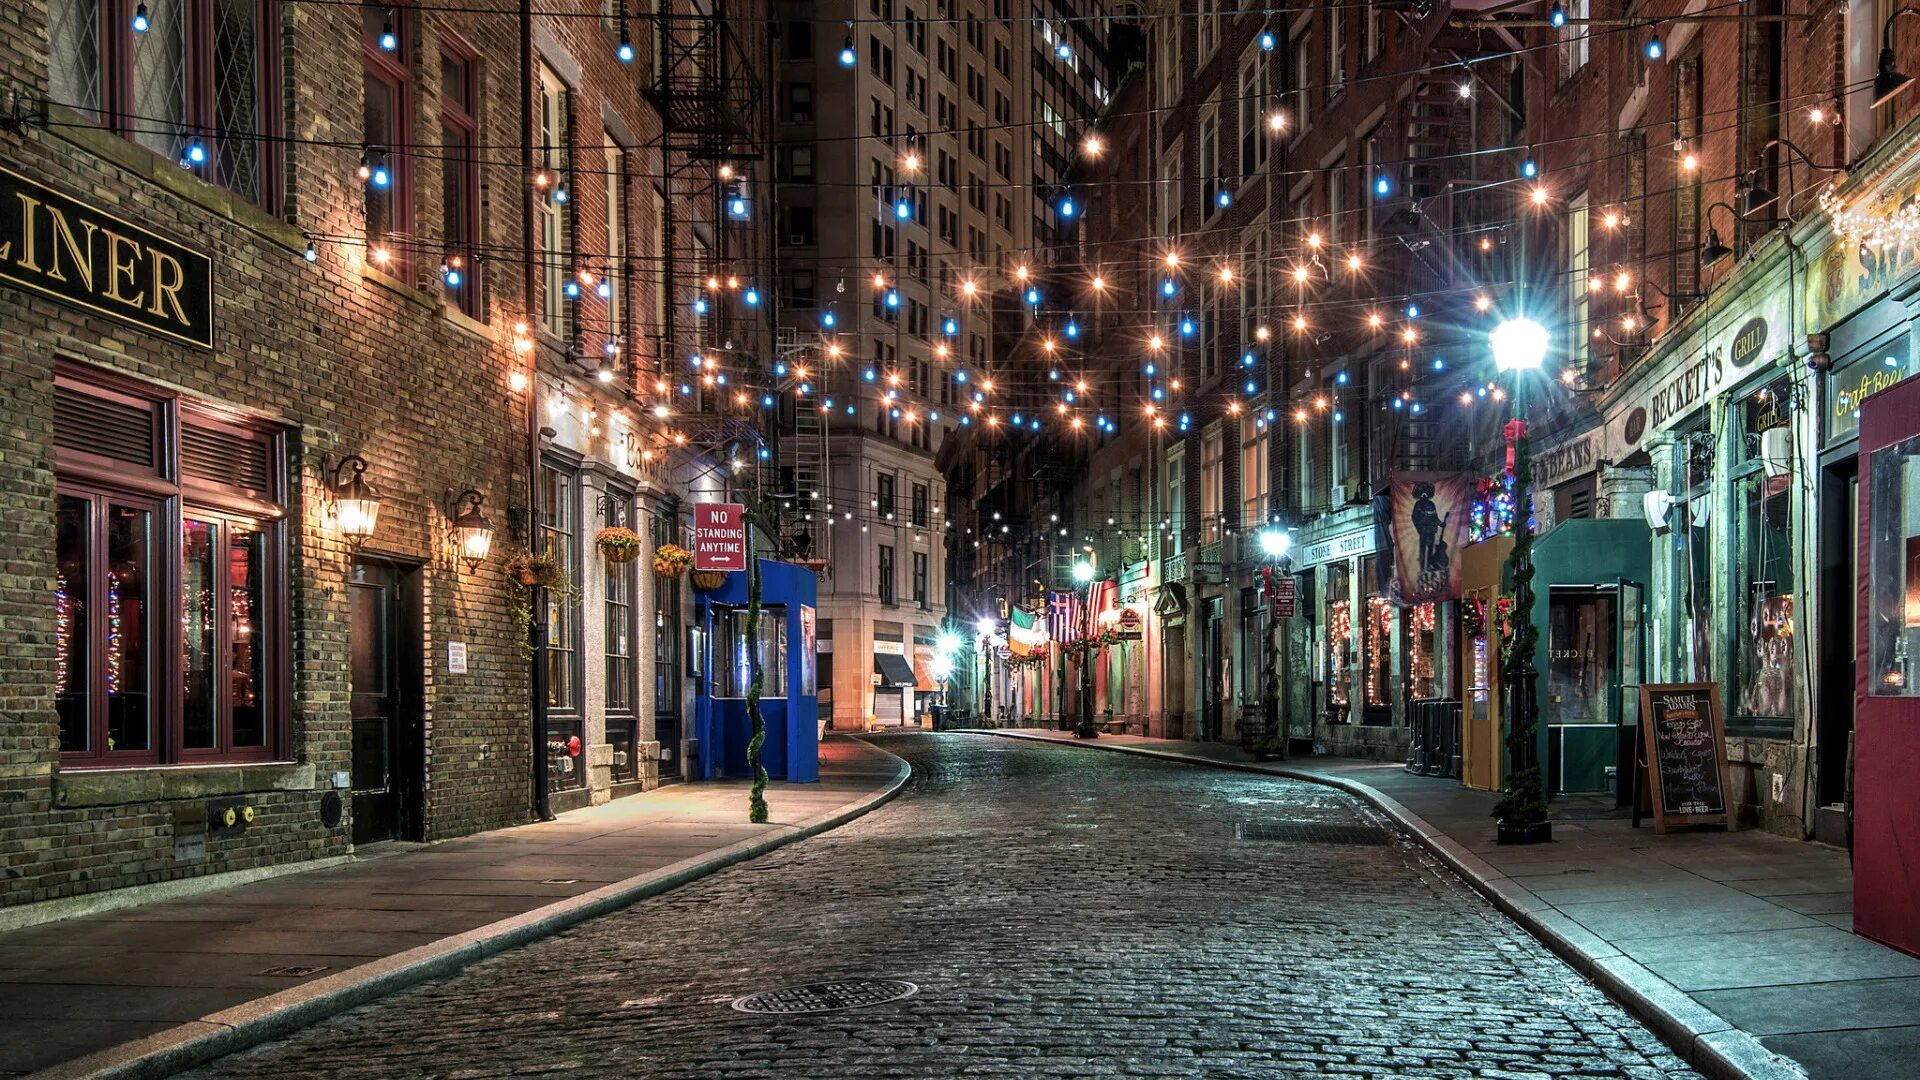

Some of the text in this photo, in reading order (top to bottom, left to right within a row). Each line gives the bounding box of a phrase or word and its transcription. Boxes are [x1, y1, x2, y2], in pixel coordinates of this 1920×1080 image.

[0, 192, 191, 326] INER
[1734, 326, 1763, 361] GRILL
[1652, 344, 1723, 429] BECKETT'S
[1836, 374, 1872, 416] Craft
[1549, 435, 1592, 479] BEANS
[711, 511, 728, 524] NO
[697, 528, 743, 539] STANDING
[700, 542, 740, 553] ANYTIME
[1311, 535, 1366, 560] STONE STREET
[1663, 694, 1698, 705] SAMUEL
[1667, 702, 1696, 711] ADAMS
